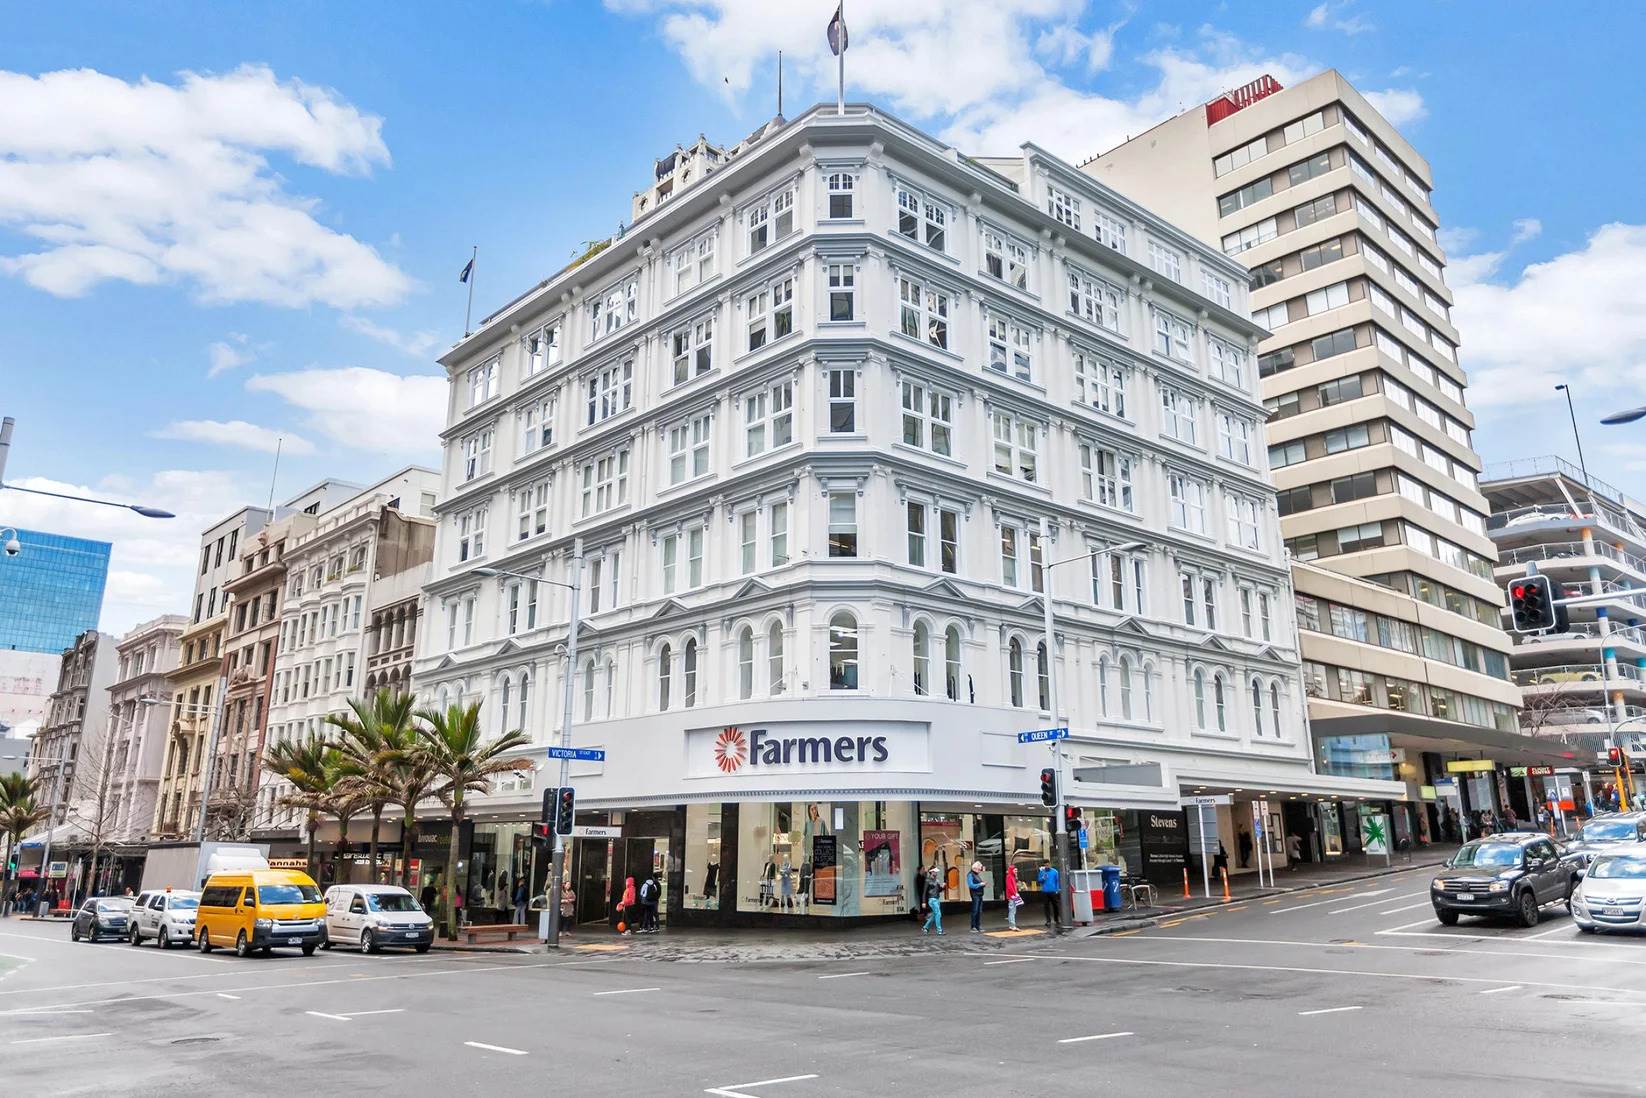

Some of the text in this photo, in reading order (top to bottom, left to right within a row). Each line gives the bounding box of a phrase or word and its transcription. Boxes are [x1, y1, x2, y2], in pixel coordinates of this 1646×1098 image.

[1031, 731, 1048, 741] QUEEN
[750, 729, 889, 765] Farmers
[551, 749, 577, 759] VICTORIA
[1150, 814, 1177, 829] Stevens
[585, 828, 607, 836] Farmers
